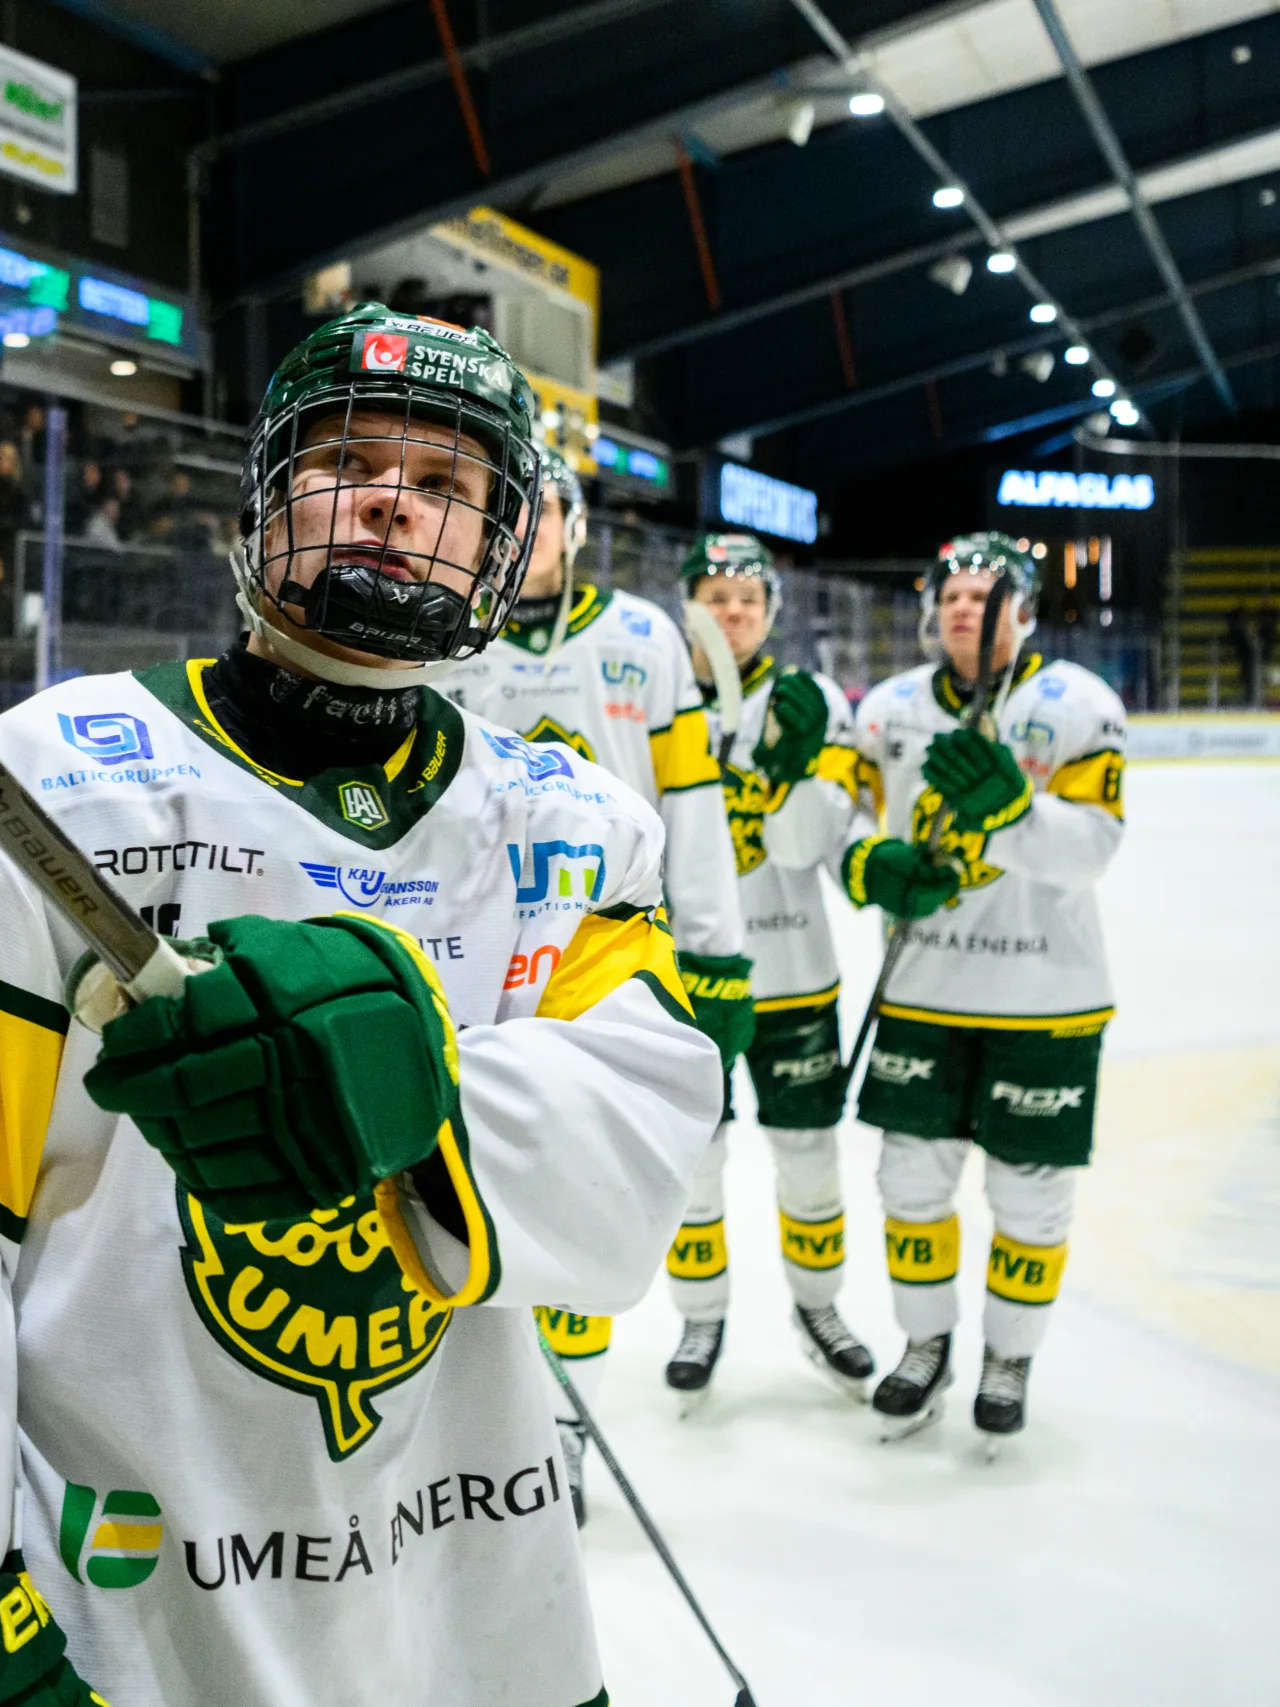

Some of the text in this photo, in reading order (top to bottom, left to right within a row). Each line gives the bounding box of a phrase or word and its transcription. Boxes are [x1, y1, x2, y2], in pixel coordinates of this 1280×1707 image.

[410, 362, 461, 385] SPEL
[413, 344, 504, 387] SVENSKA
[41, 763, 202, 792] BALTICGRUPPEN
[347, 868, 377, 882] KAJ
[384, 896, 422, 907] ÅKERI
[183, 1455, 561, 1591] UMEÅ ENERGI
